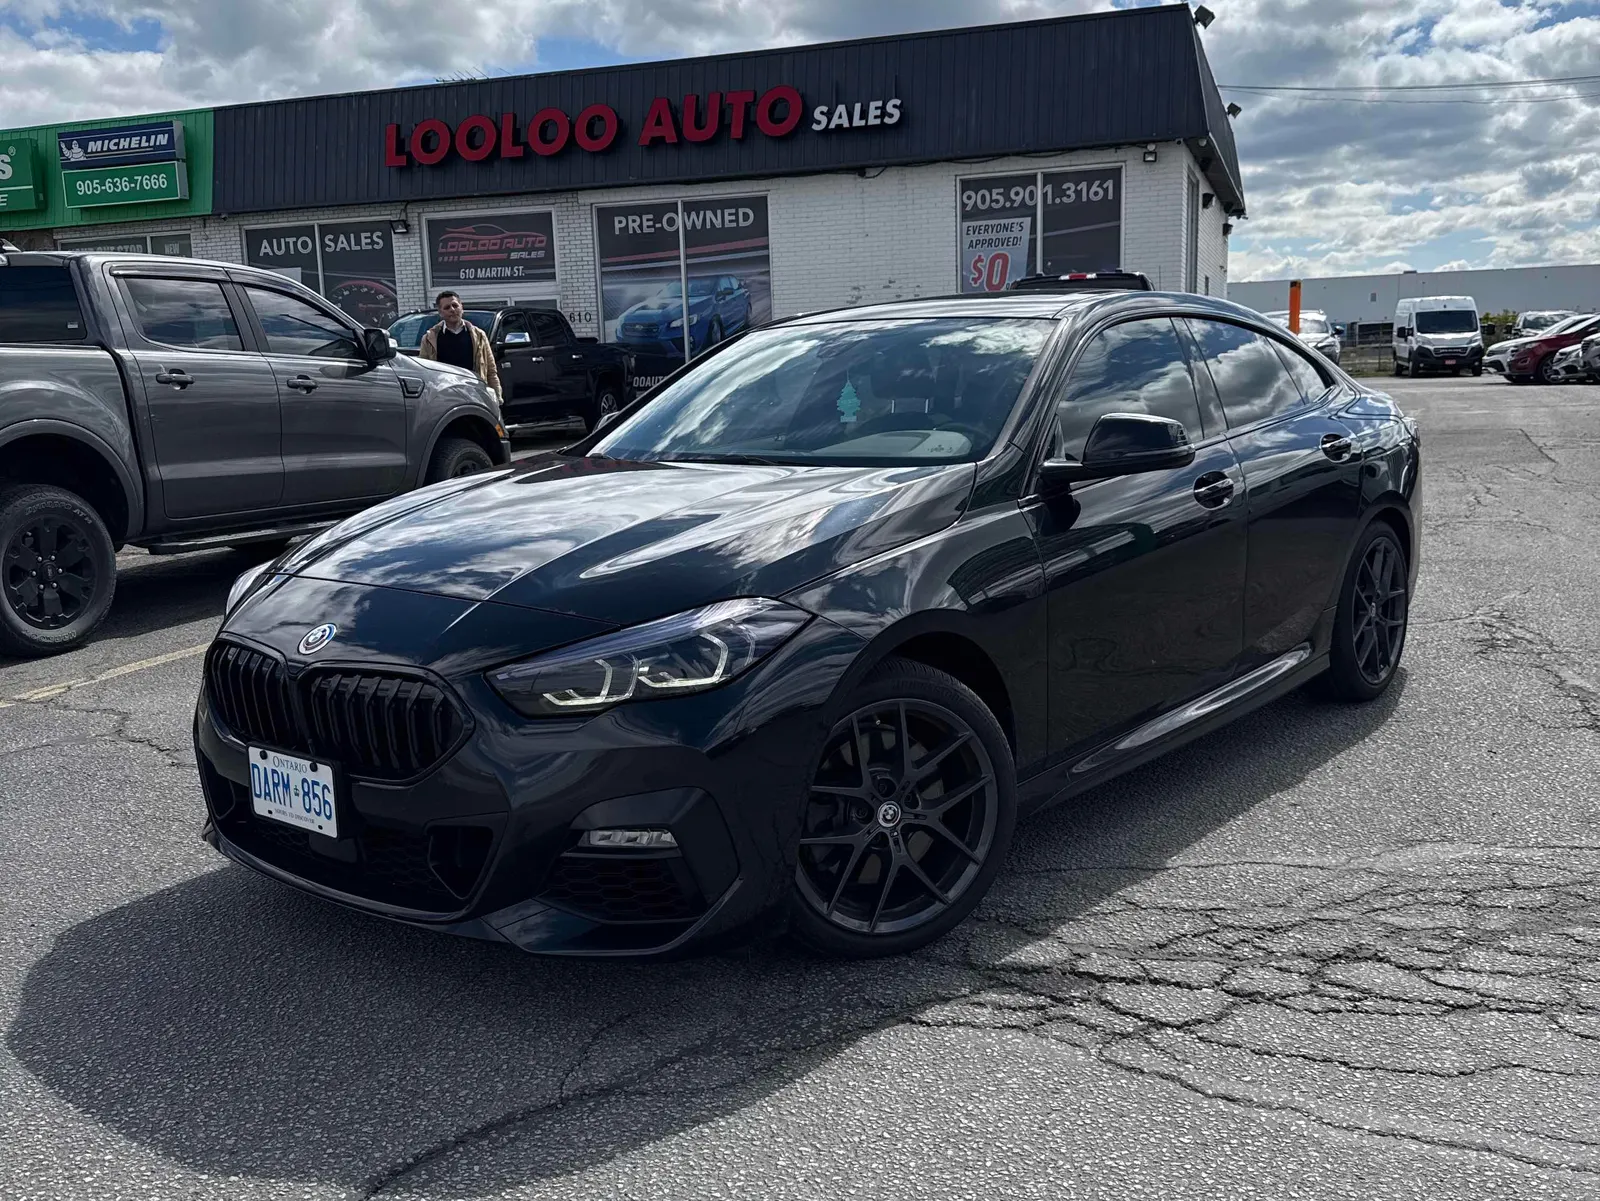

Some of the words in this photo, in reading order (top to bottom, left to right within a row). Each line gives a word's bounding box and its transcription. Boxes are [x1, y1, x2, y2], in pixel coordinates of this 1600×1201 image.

[384, 104, 618, 167] LOOLOO
[638, 84, 804, 146] AUTO
[811, 98, 902, 131] SALES
[87, 133, 169, 153] MICHELIN
[76, 173, 168, 196] 905-636-7666
[962, 179, 1114, 211] 905.901.3161
[614, 207, 755, 235] PRE-OWNED
[965, 221, 1025, 236] EVERYONE'S
[164, 242, 180, 255] NEW
[259, 236, 313, 257] AUTO
[324, 231, 384, 253] SALES
[437, 239, 501, 253] LOOLOO
[502, 236, 548, 250] AUTO
[967, 236, 1023, 250] APPROVED!
[510, 250, 546, 260] SALES
[460, 268, 475, 280] 610
[477, 266, 511, 279] MARTIN
[513, 265, 525, 277] ST.
[969, 251, 1010, 292] $0
[569, 311, 592, 323] 610
[272, 755, 308, 774] ONTARIO
[251, 763, 293, 809] DARM
[301, 777, 332, 820] 856
